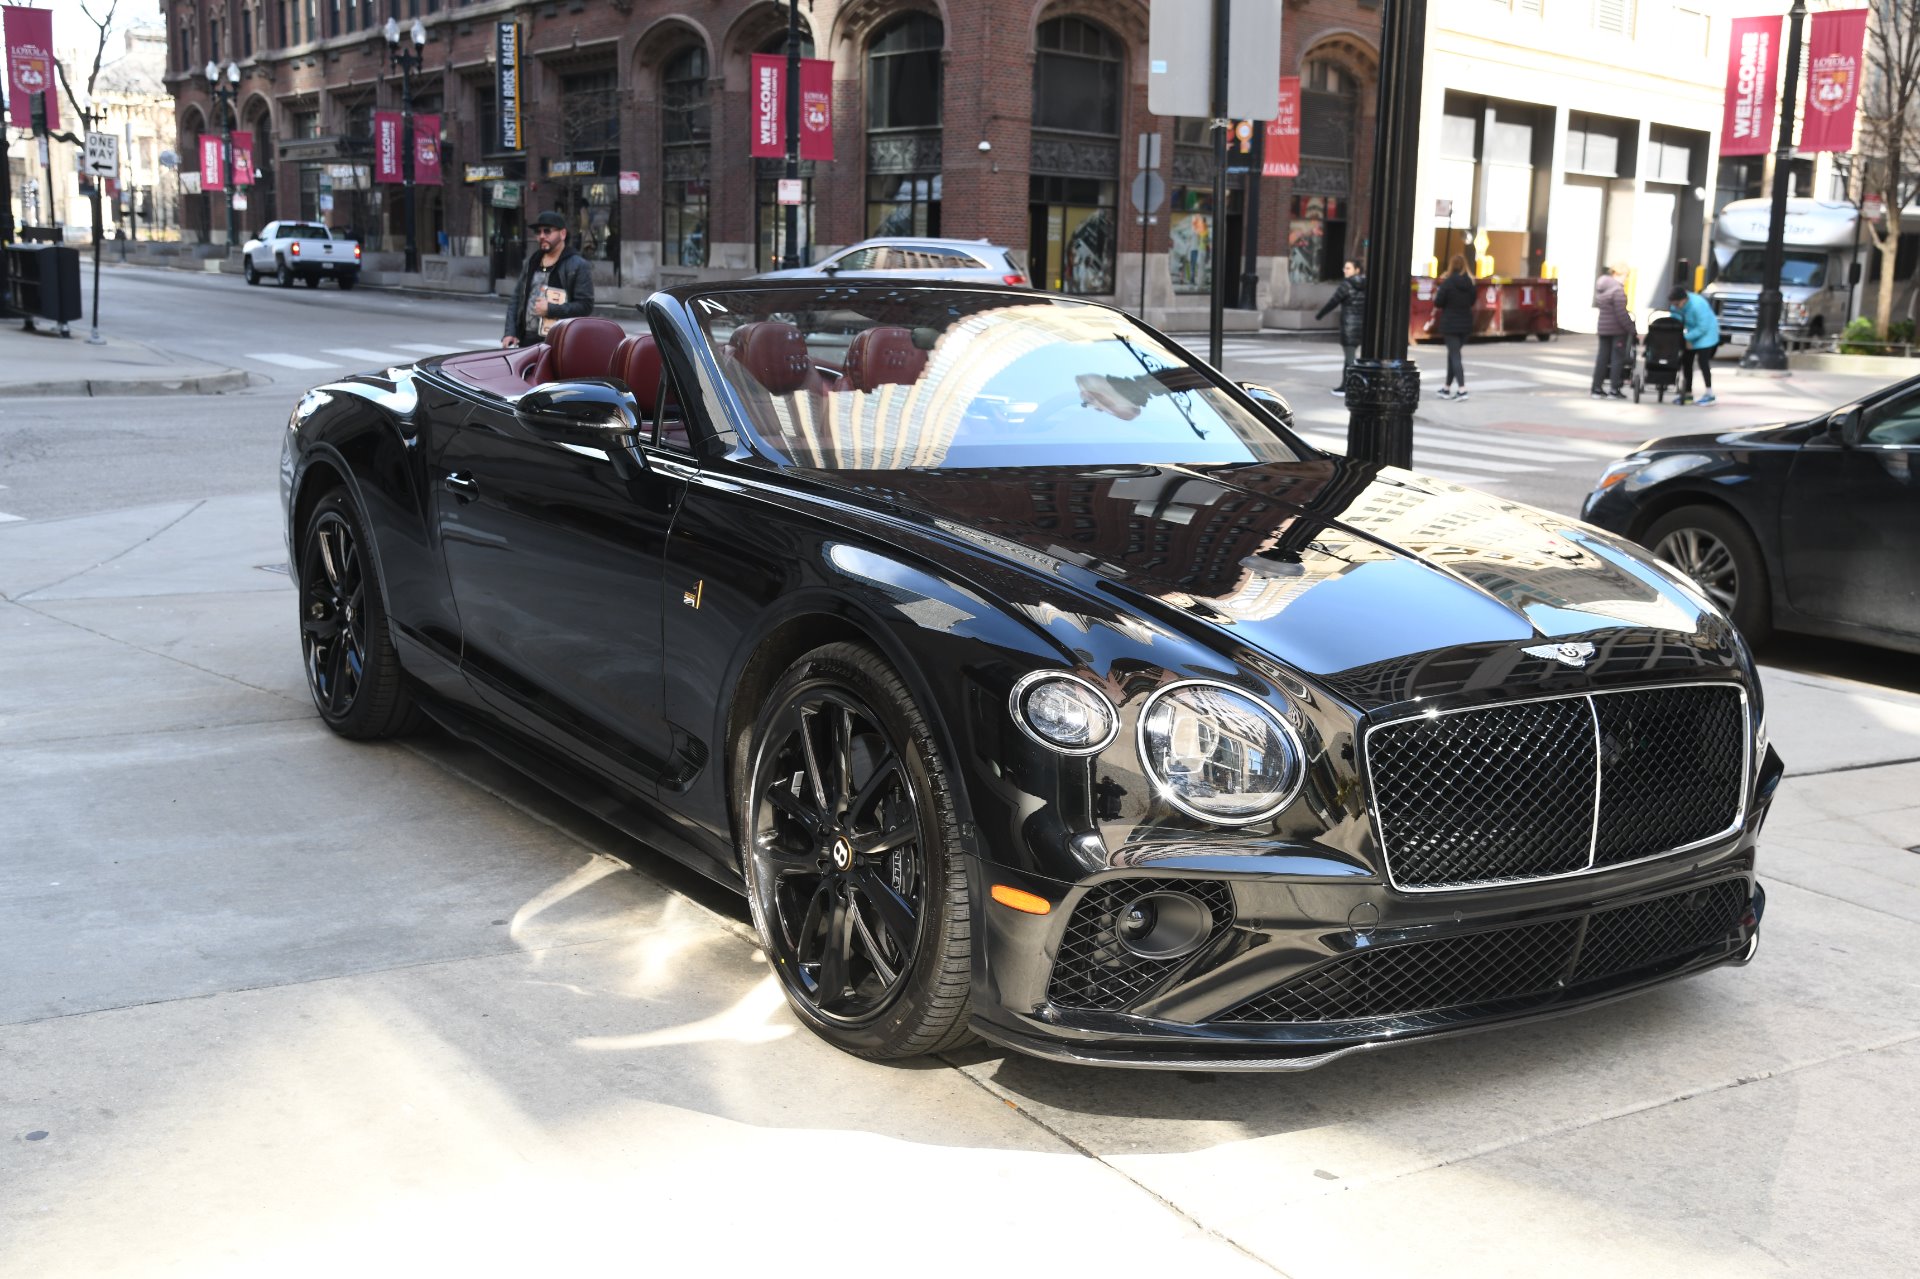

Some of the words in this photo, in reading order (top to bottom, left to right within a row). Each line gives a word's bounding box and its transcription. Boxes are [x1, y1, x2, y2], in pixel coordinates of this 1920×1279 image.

[11, 46, 49, 57] LOYOLA
[502, 24, 515, 65] BAGELS
[1813, 56, 1855, 67] LOYOLA
[1733, 32, 1759, 138] WELCOME
[1754, 73, 1766, 105] TOWER
[760, 67, 771, 145] WELCOME
[1751, 107, 1762, 138] WATER
[89, 136, 114, 149] ONE
[504, 101, 517, 148] EINSTEIN
[89, 148, 114, 159] WAY
[382, 121, 391, 174] WELCOME
[893, 850, 901, 894] NTLEY
